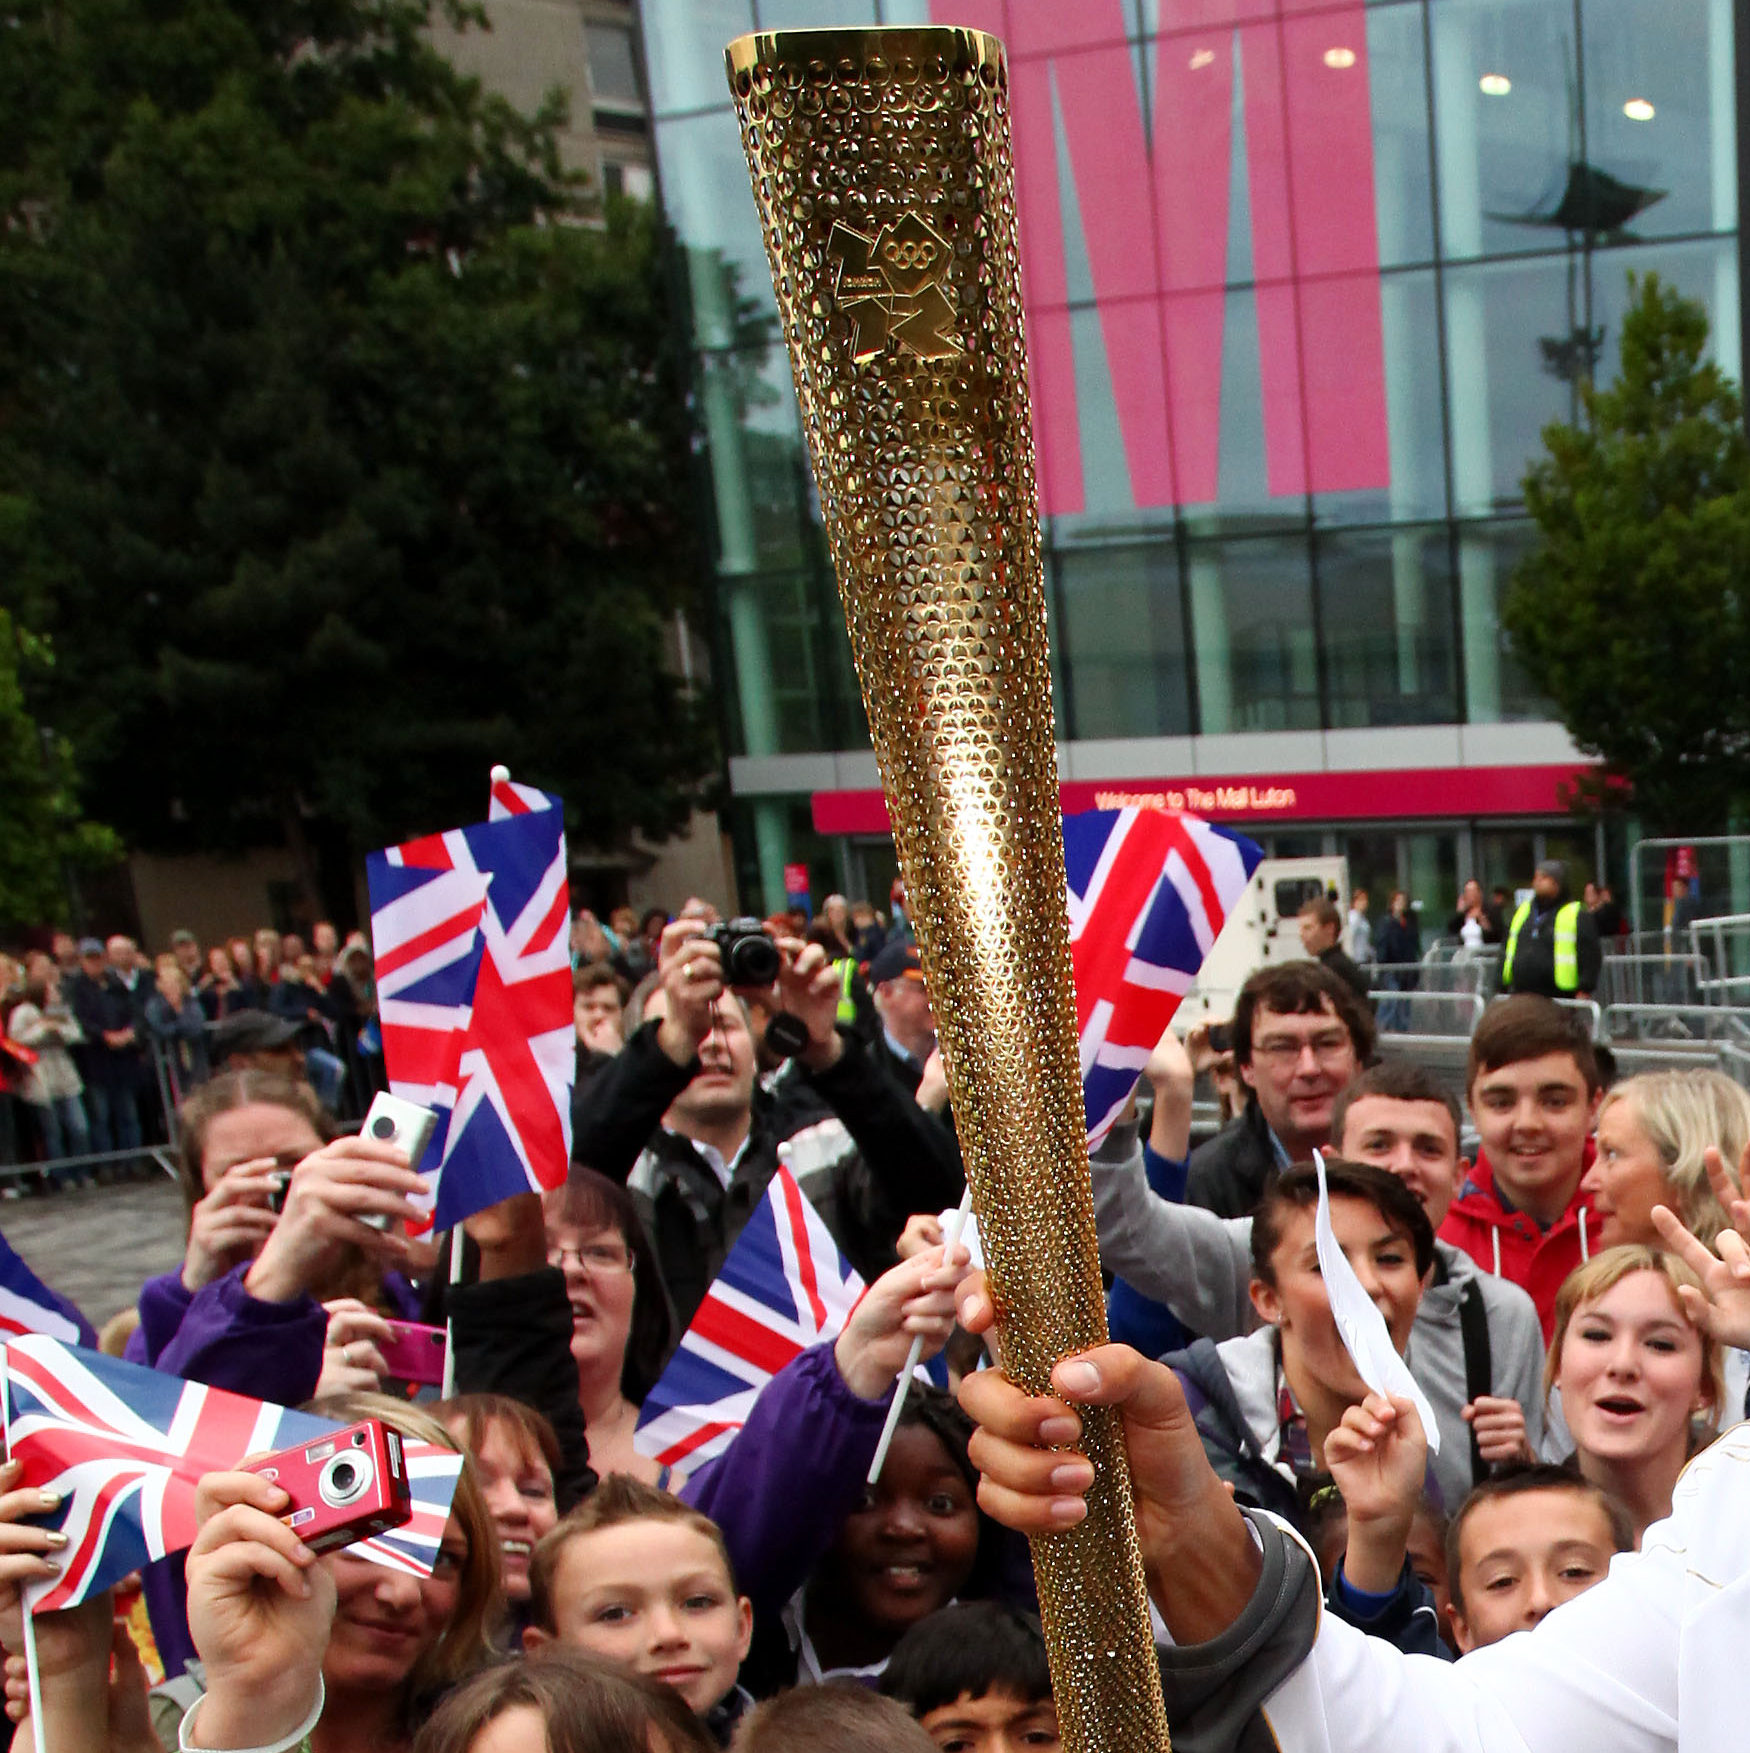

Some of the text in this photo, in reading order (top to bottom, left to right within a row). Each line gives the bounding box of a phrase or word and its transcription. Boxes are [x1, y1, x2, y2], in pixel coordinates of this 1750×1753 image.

[1095, 786, 1296, 811] Welcome to The Mall Luton
